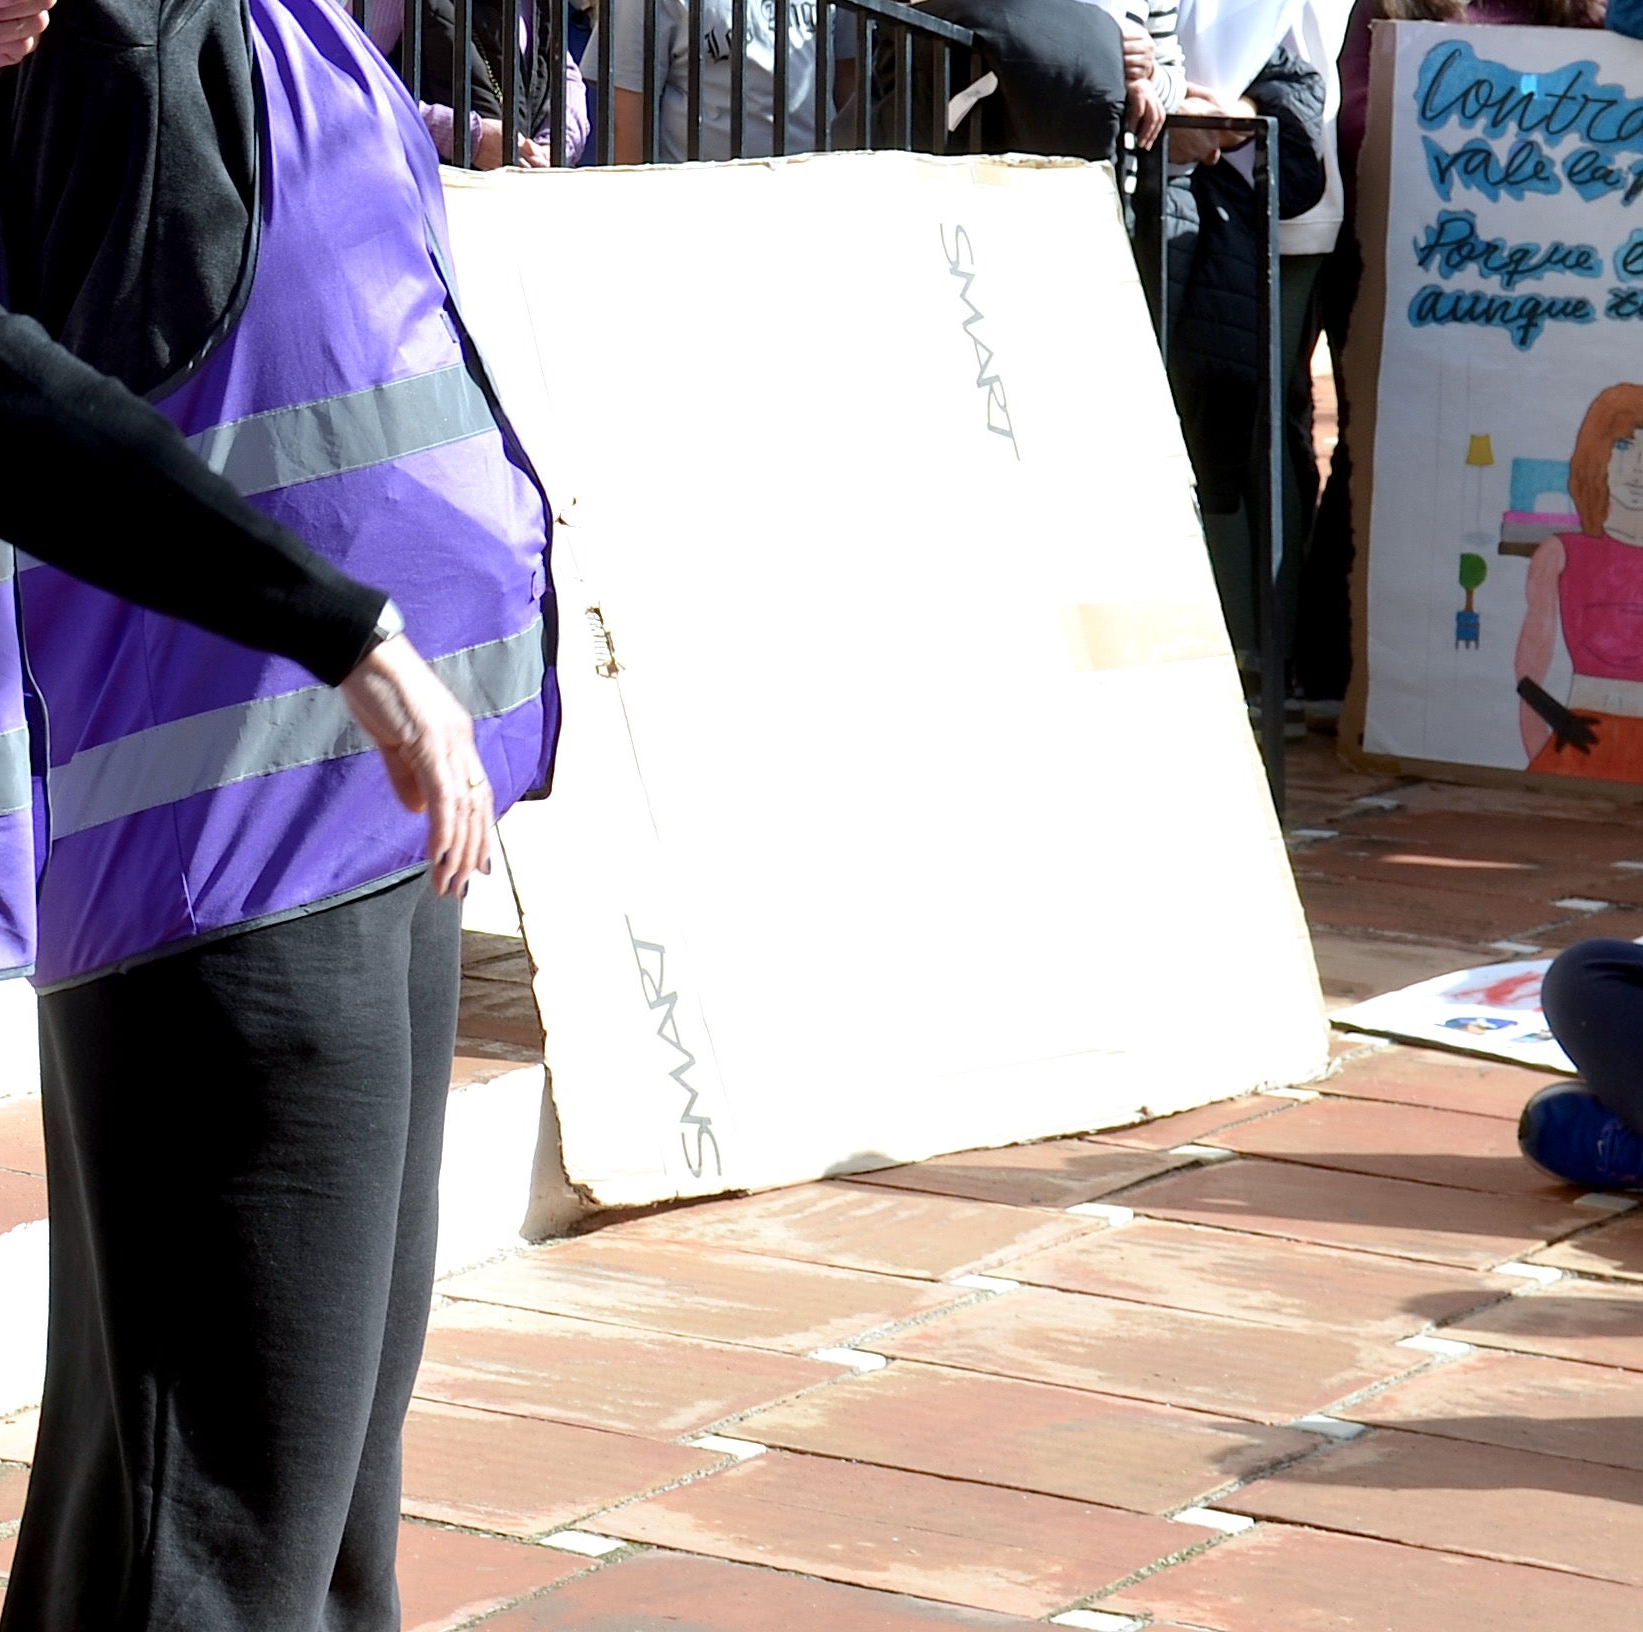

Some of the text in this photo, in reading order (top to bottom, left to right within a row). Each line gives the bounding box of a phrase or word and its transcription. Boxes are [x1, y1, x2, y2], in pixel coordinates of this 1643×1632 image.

[1434, 142, 1550, 186] vale
[1567, 150, 1621, 186] la
[1418, 218, 1594, 287] Porque
[940, 223, 1020, 461] SMART
[1416, 290, 1591, 346] aunque
[624, 914, 722, 1178] SMART
